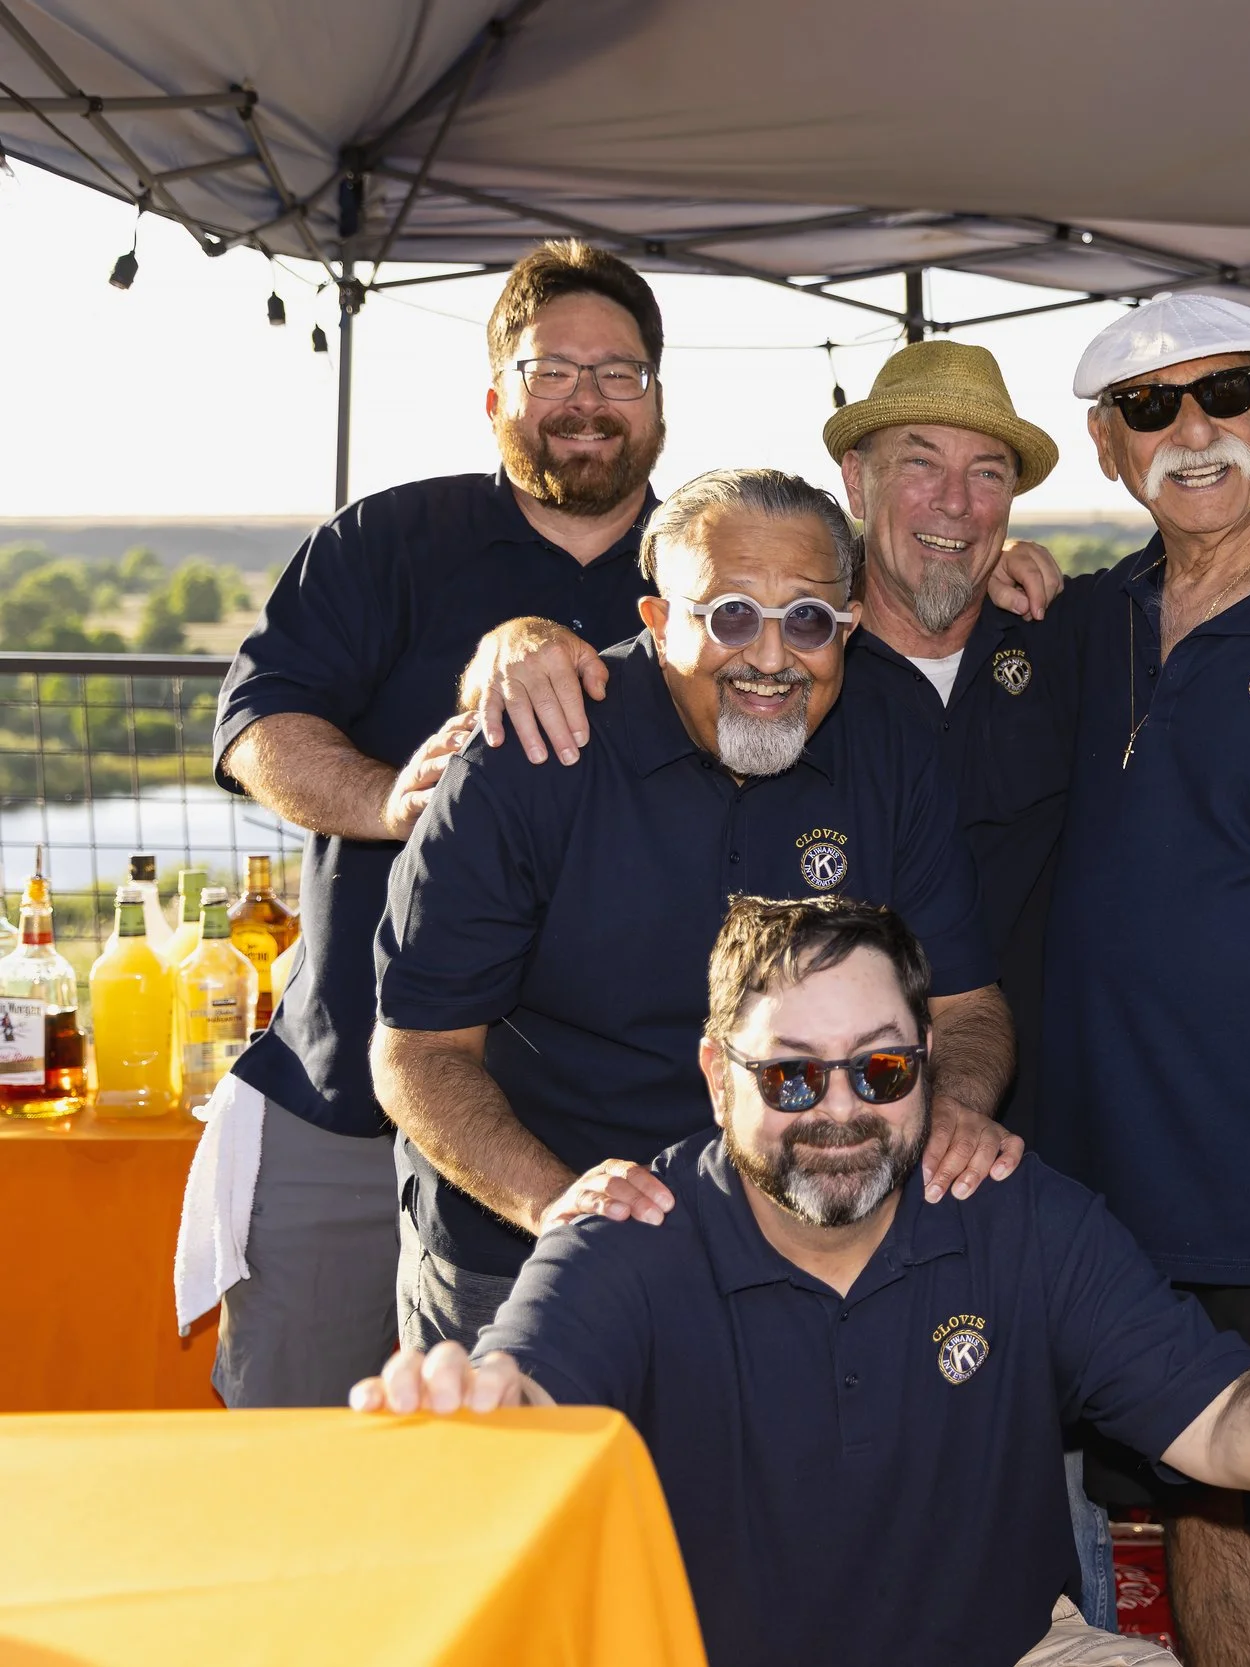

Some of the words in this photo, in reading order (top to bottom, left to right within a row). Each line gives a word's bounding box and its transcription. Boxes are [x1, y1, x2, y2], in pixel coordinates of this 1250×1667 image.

[795, 828, 849, 848] CLOVIS
[808, 846, 840, 859] KIWANIS
[814, 853, 835, 879] K
[932, 1314, 986, 1342] CLOVIS
[945, 1334, 980, 1352] KIWANIS
[952, 1342, 976, 1374] K
